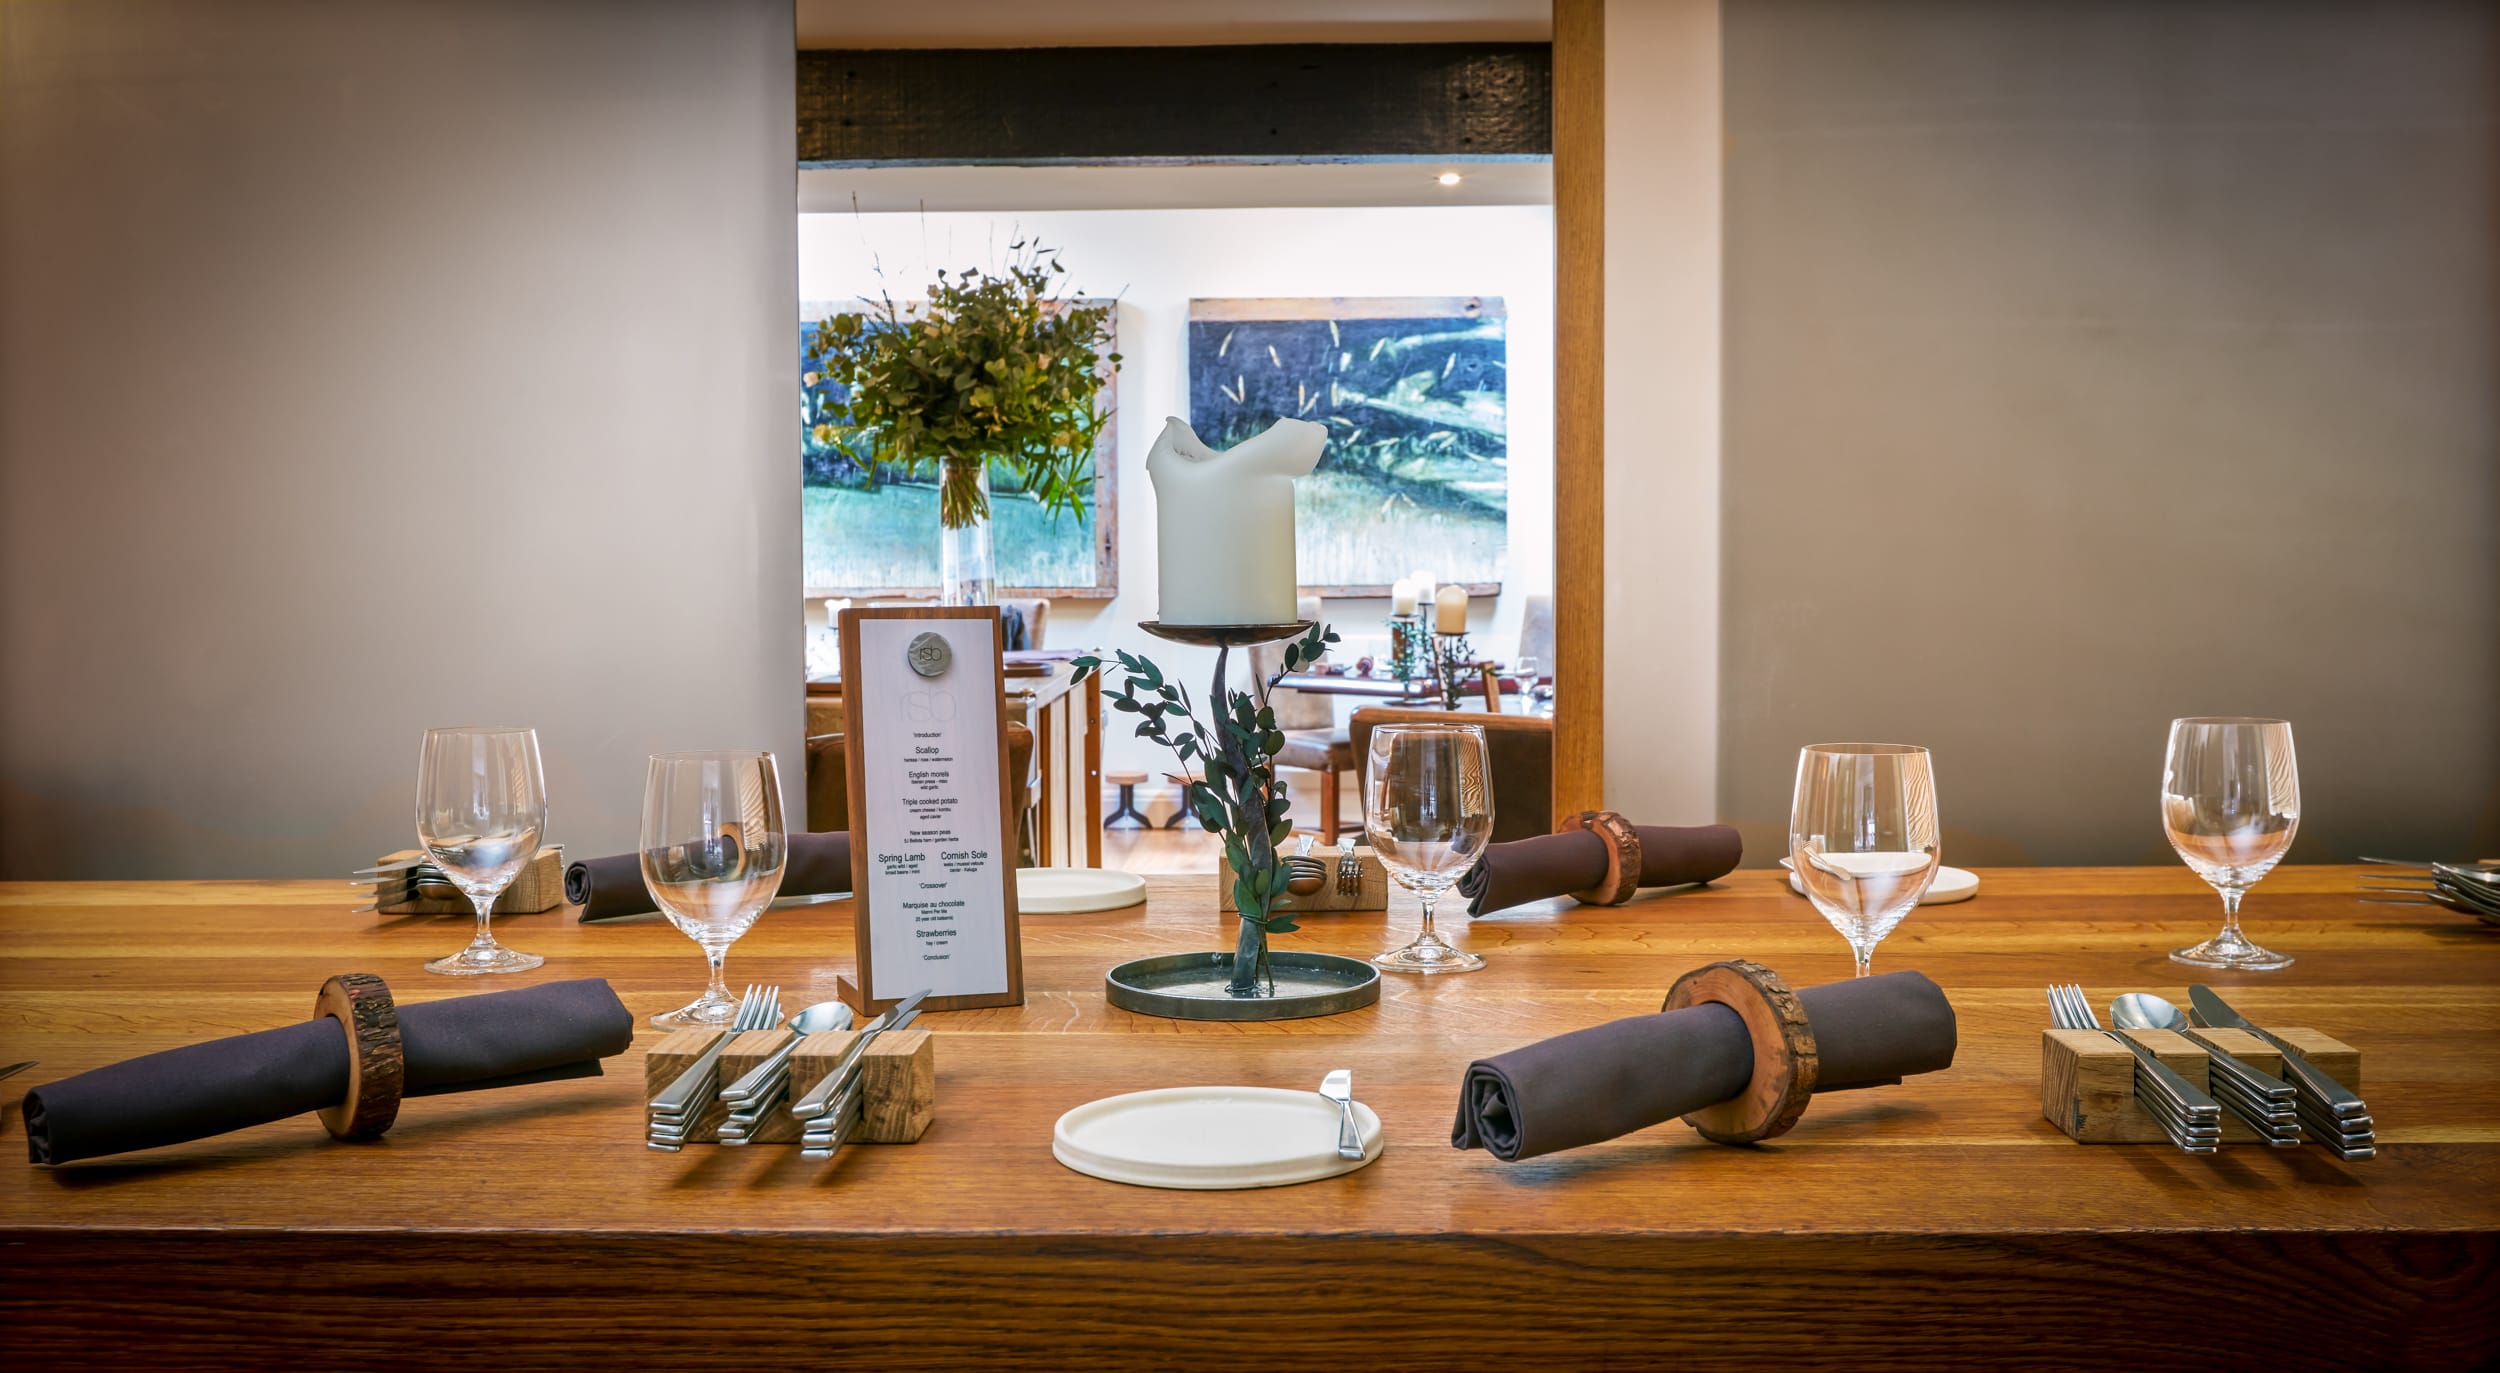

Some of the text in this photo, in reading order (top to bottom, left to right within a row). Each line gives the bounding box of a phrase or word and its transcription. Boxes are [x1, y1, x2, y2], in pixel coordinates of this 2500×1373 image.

[916, 746, 940, 755] Scallop
[908, 770, 929, 780] English
[902, 798, 918, 806] Triple
[878, 852, 926, 864] Spring Lamb
[940, 850, 988, 860] Cornish Sole
[902, 902, 928, 910] Marquise
[916, 930, 957, 938] Strawberries
